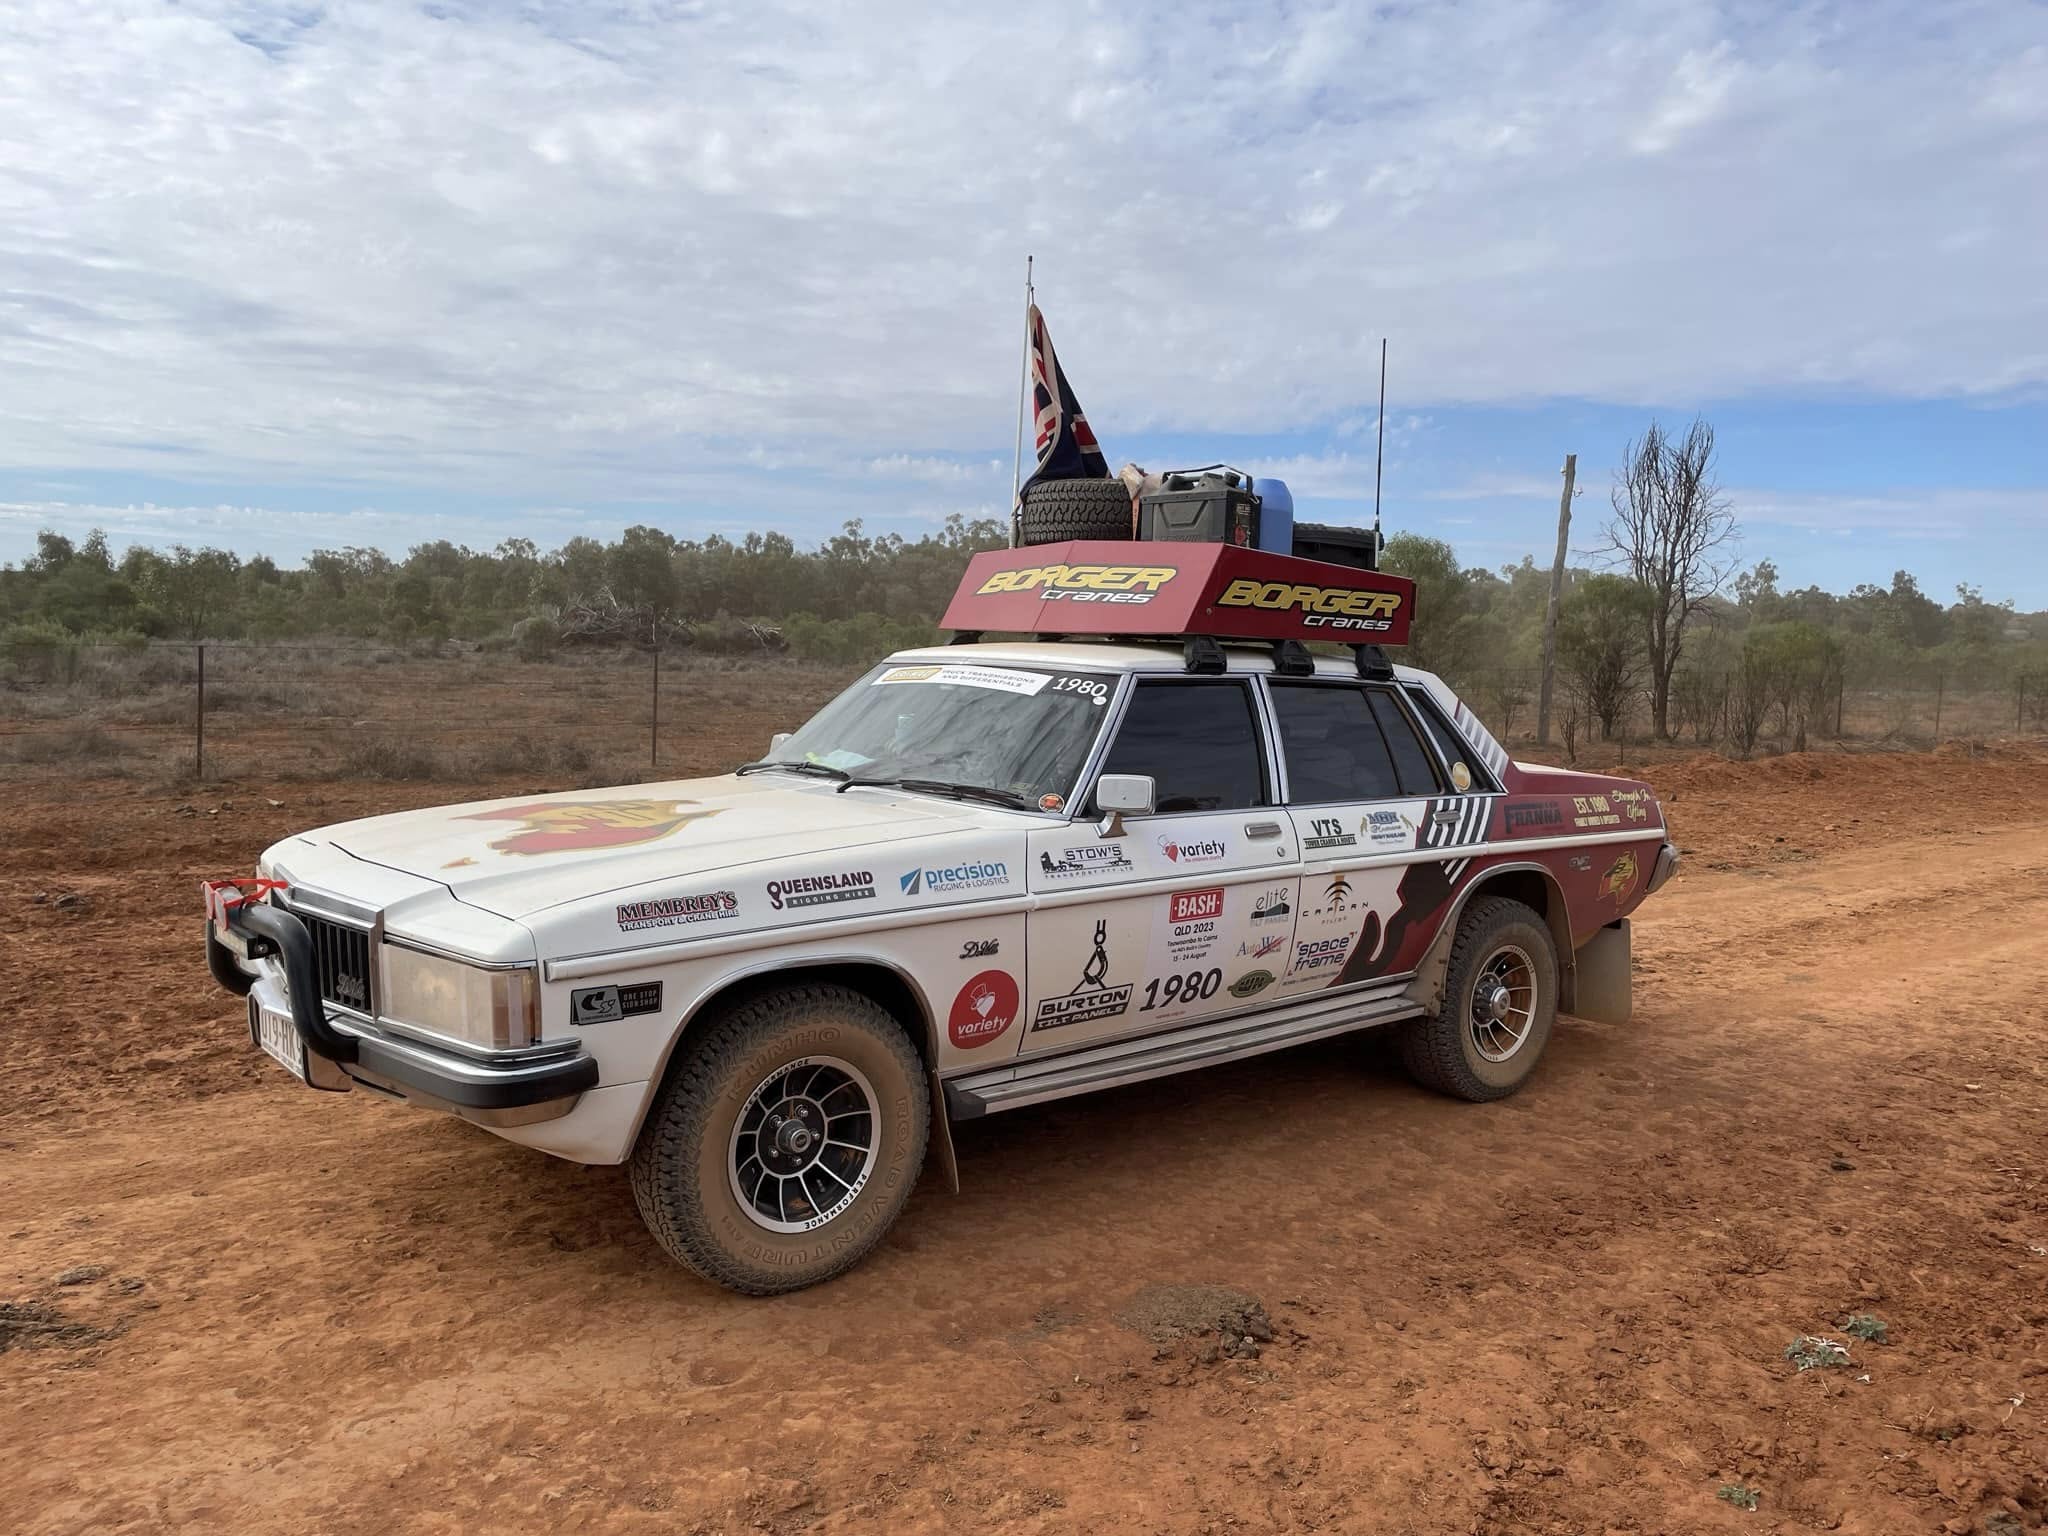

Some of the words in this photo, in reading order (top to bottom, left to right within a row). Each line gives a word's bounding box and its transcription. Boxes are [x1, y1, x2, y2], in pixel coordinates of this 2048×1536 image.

[976, 565, 1177, 594] BORGER
[1040, 589, 1154, 604] cranes
[1217, 579, 1402, 618] BORGER
[1303, 615, 1392, 631] cranes
[960, 675, 1022, 687] DIFFERENTIALS
[968, 671, 1036, 684] TRANSMISSIONS
[1052, 676, 1108, 698] 1980
[1573, 797, 1592, 813] EST.
[1310, 818, 1342, 836] VTS
[1066, 846, 1121, 861] STOW'S
[1179, 840, 1225, 857] variety
[925, 861, 1007, 888] precision
[934, 882, 965, 892] RIGGING
[973, 876, 1009, 887] LOGISTICS
[767, 871, 874, 910] QUEENSLAND
[792, 893, 839, 905] RIGGING
[1256, 888, 1288, 910] elite
[617, 891, 738, 923] MEMBREY'S
[1178, 894, 1216, 917] BASH
[620, 916, 676, 932] TRANSPORT
[686, 912, 718, 924] CRANE
[718, 909, 739, 919] HIRE
[1174, 925, 1191, 937] QLD
[1193, 921, 1214, 933] 2023
[1298, 937, 1350, 958] space
[1294, 953, 1345, 971] frame
[1139, 968, 1222, 1012] 1980
[1041, 989, 1128, 1016] BURTON
[958, 1016, 1007, 1035] variety
[1038, 1016, 1071, 1028] TILT
[1072, 1006, 1125, 1021] PANELS
[804, 1173, 868, 1230] PERFORMANCE
